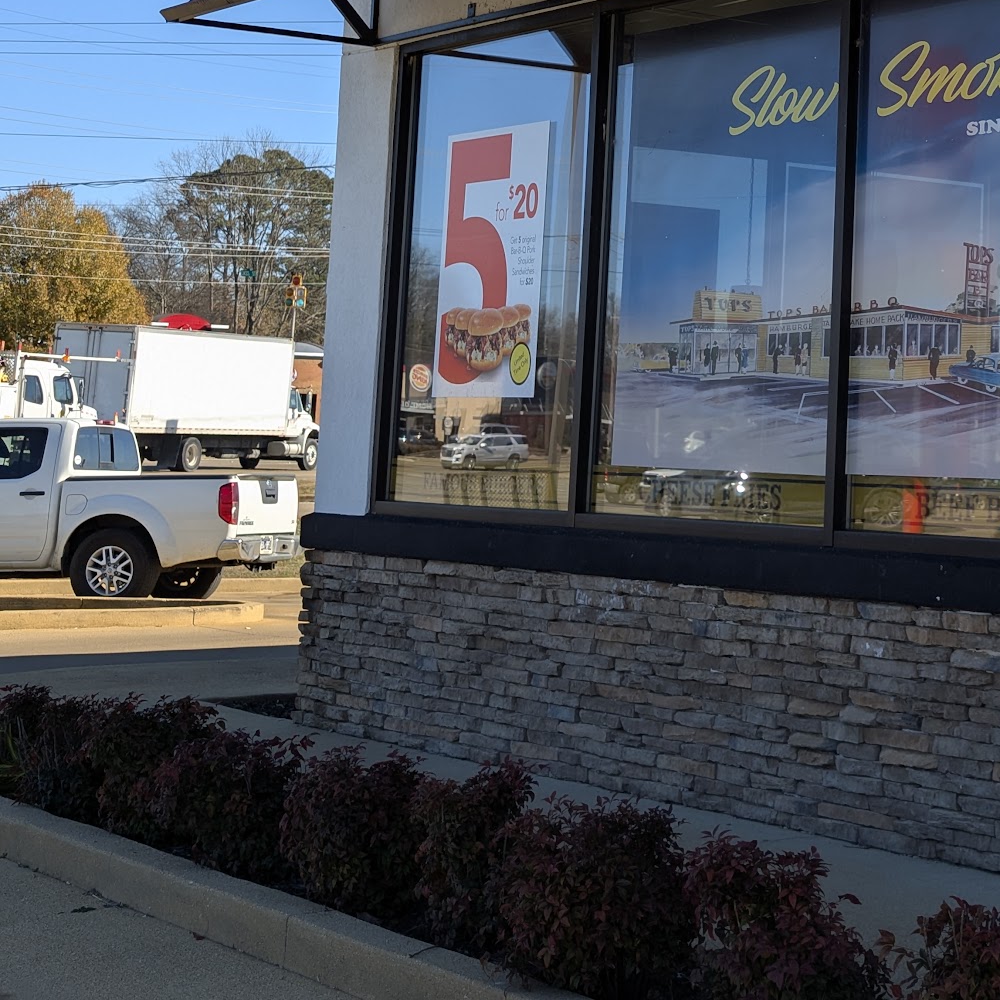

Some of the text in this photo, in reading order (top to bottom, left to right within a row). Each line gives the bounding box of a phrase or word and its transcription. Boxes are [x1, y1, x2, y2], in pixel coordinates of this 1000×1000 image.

[728, 65, 839, 136] Slow
[495, 182, 539, 222] for $20
[438, 132, 513, 385] 5
[963, 242, 995, 265] TOPS
[704, 296, 752, 313] TOPS
[767, 307, 802, 320] TOPS
[865, 315, 886, 325] HOME
